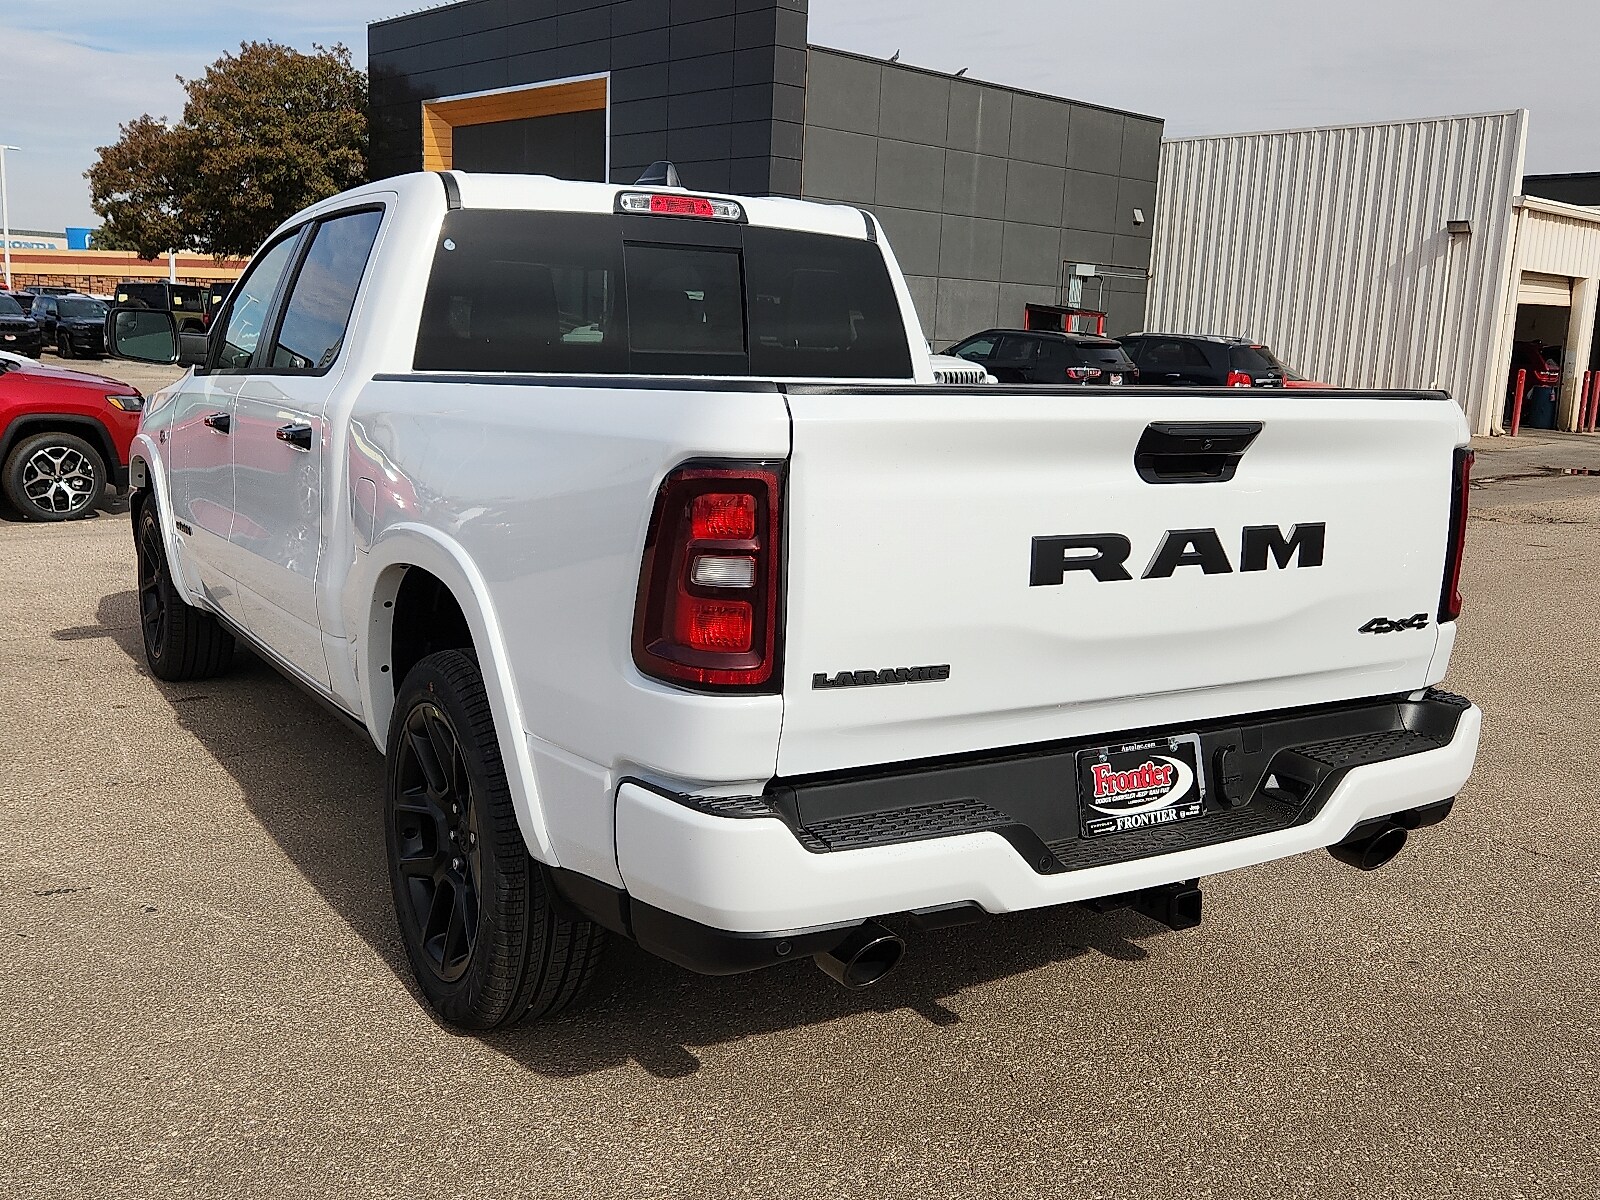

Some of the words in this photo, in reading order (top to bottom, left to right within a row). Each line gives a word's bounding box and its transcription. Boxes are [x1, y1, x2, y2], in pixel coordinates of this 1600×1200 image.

[1029, 521, 1326, 587] RAM
[1358, 613, 1430, 635] 4x4
[812, 664, 950, 690] LARAMIE
[1091, 761, 1173, 797] Frontier
[1116, 808, 1177, 830] FRONTIER
